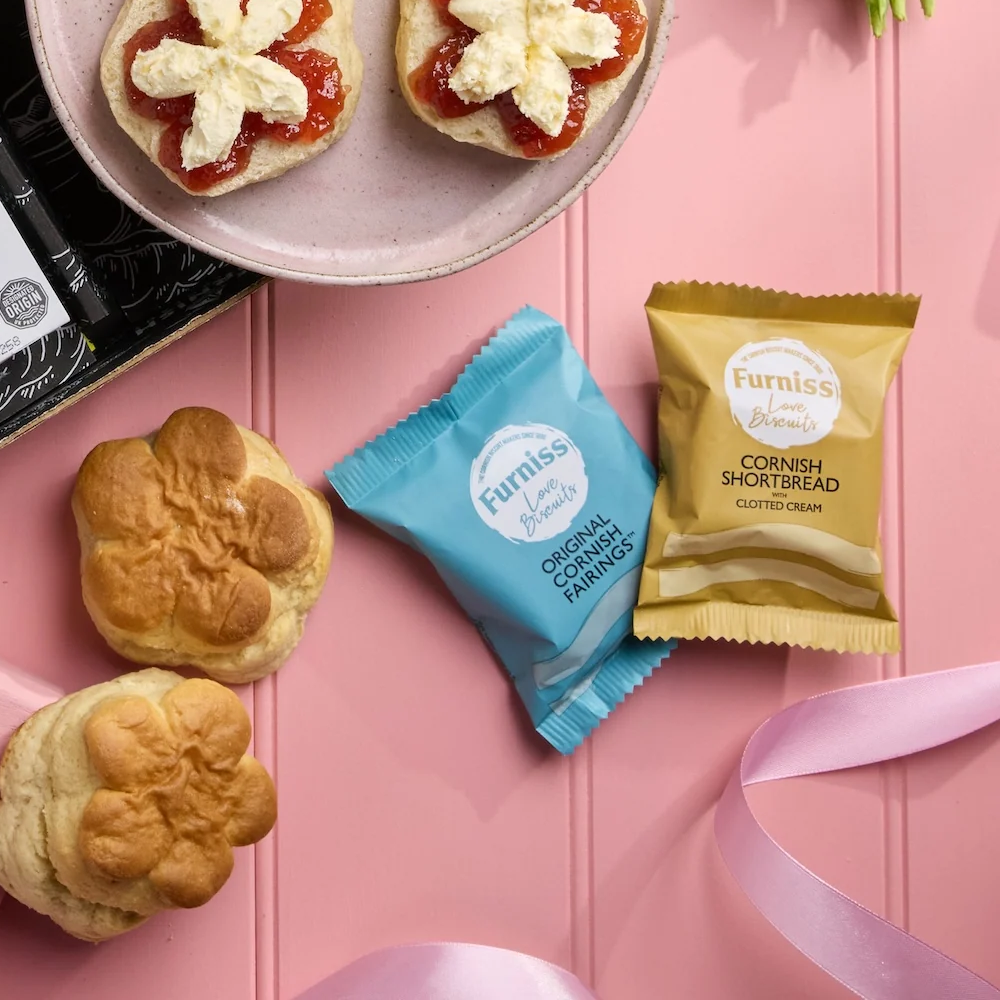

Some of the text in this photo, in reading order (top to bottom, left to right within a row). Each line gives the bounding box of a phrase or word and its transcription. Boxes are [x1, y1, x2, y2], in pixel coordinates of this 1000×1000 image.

[2, 284, 34, 307] DESIGNATED
[6, 290, 42, 318] ORIGIN
[732, 368, 834, 398] Furniss
[768, 393, 806, 414] Love
[748, 406, 818, 432] Biscuits
[478, 438, 569, 516] Furniss
[741, 455, 822, 474] CORNISH
[523, 478, 558, 512] Love
[722, 471, 840, 492] SHORTBREAD
[520, 482, 578, 537] Biscuits
[736, 499, 822, 513] CLOTTED CREAM
[541, 514, 611, 575] ORIGINAL
[553, 524, 622, 588] CORNISH
